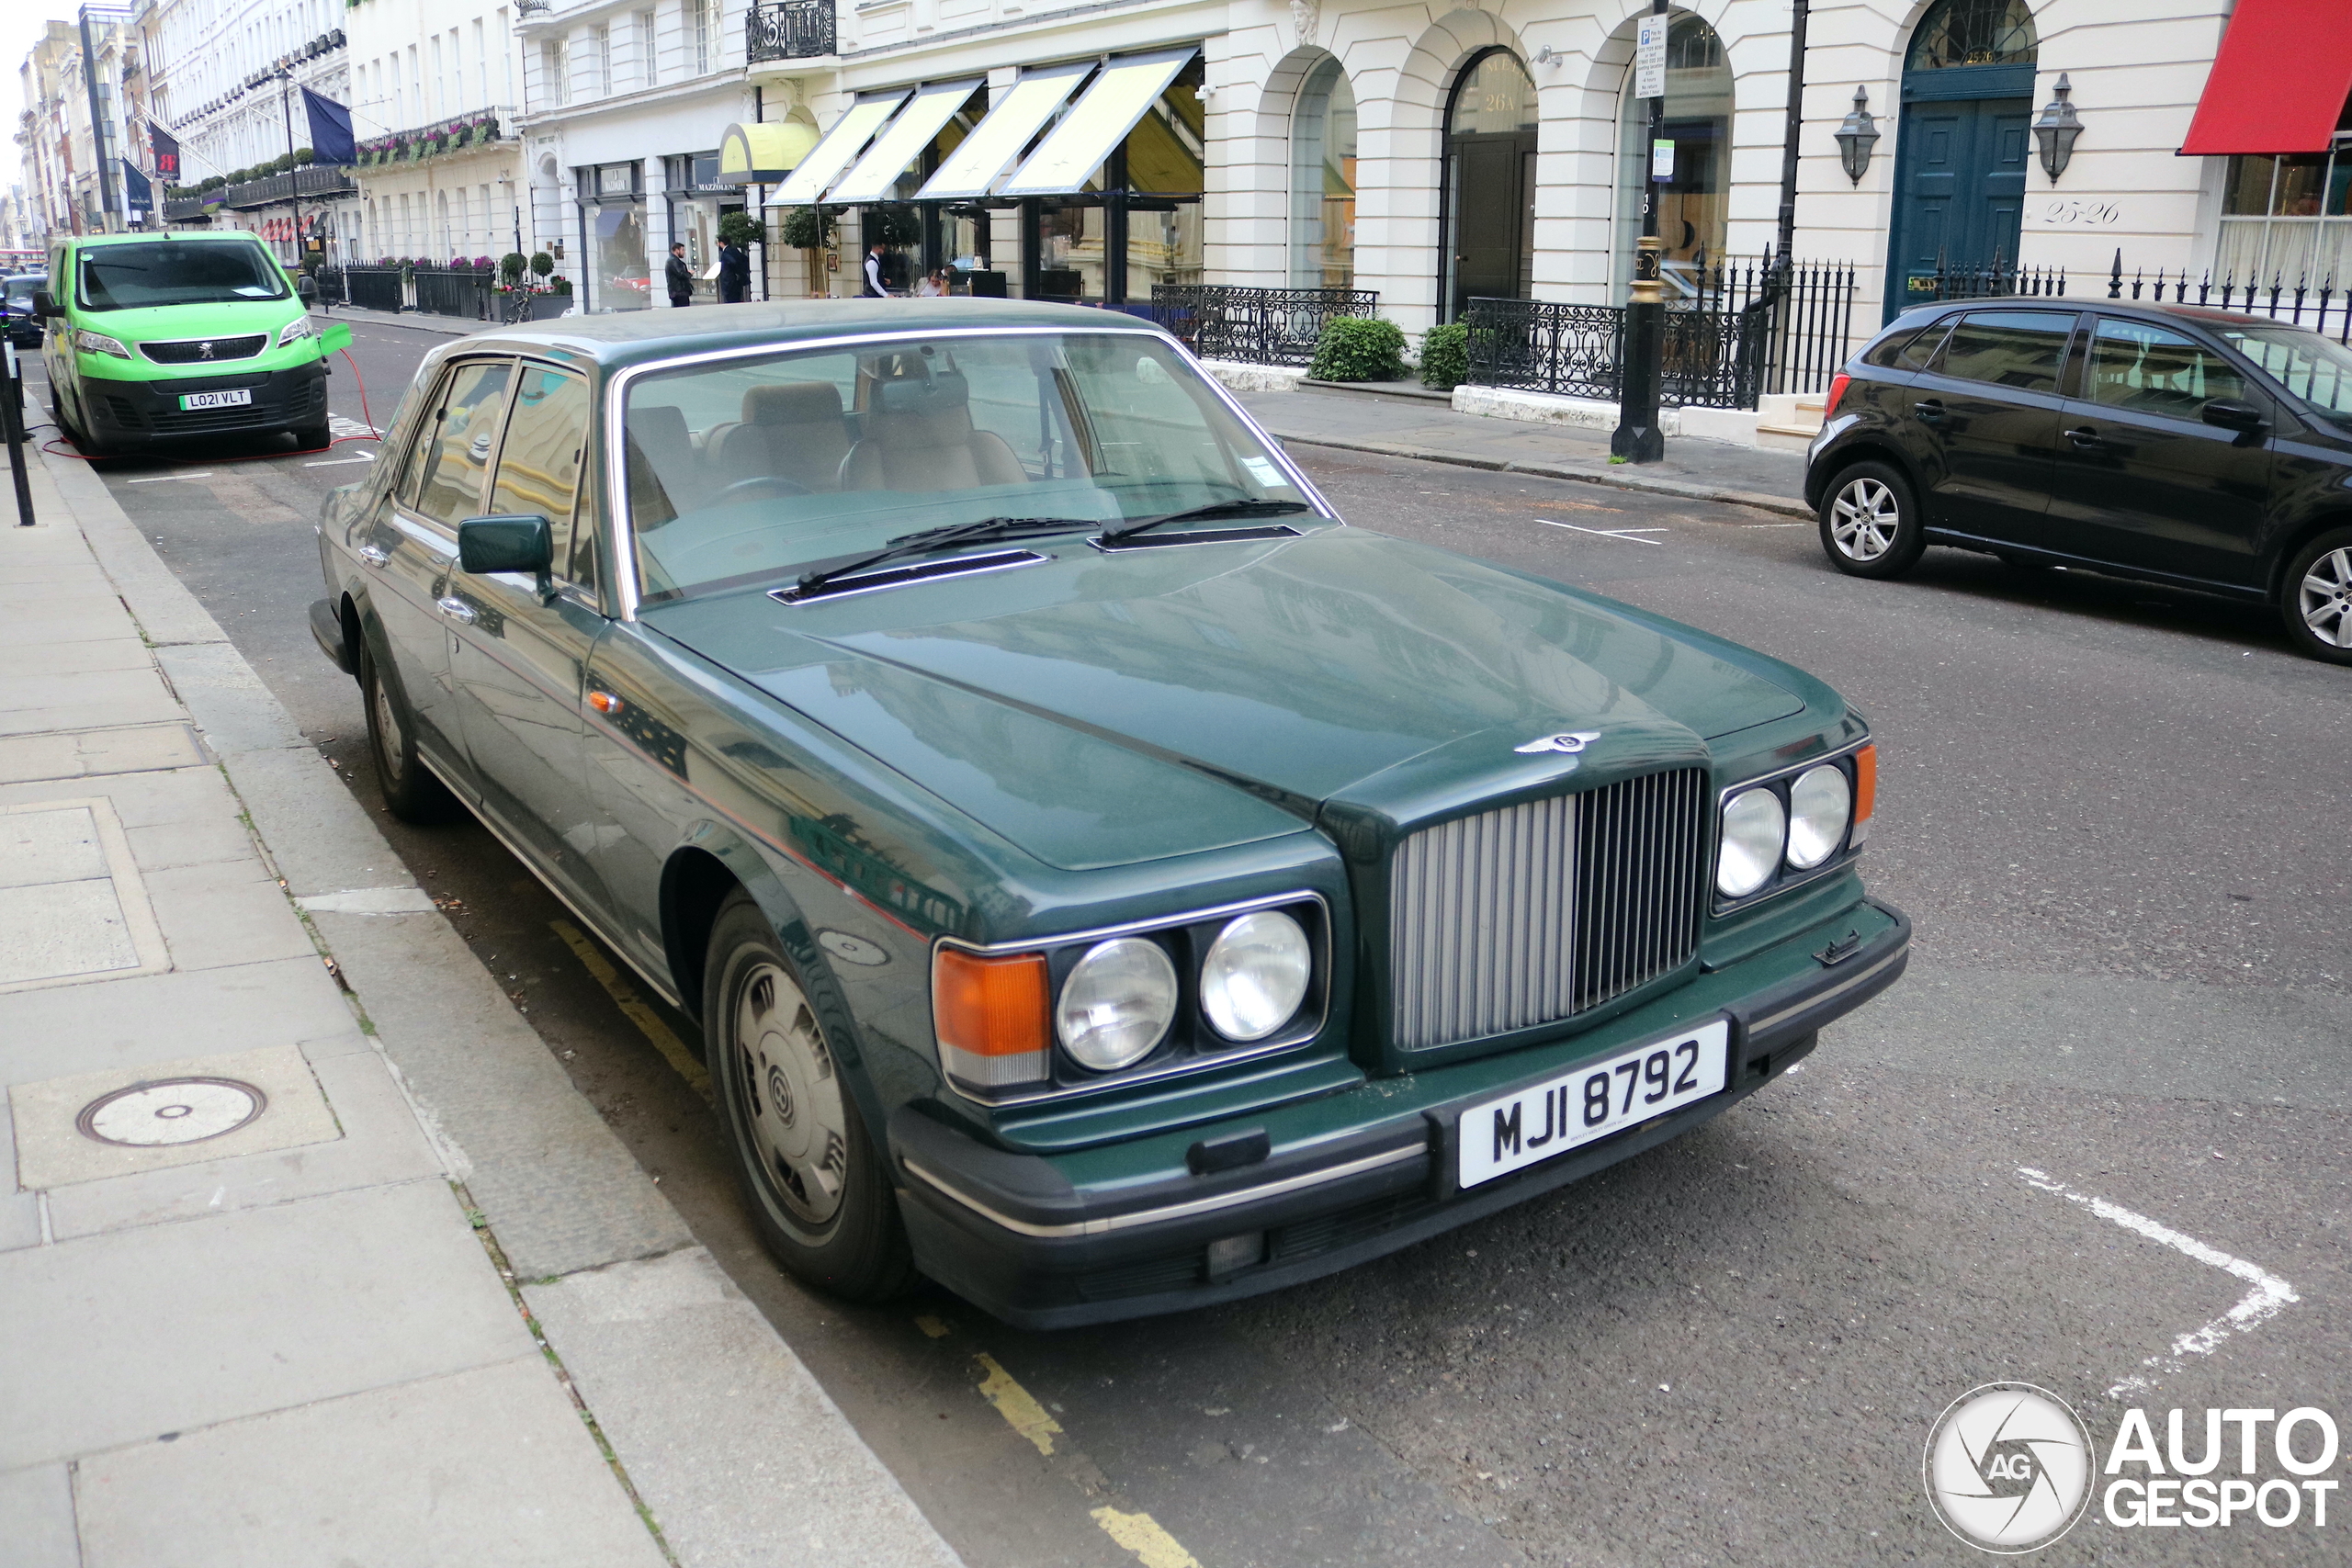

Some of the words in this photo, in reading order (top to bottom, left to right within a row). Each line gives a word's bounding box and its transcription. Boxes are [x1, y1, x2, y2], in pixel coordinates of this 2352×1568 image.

[1486, 93, 1514, 112] 26A
[698, 183, 736, 191] MAZZOLENI
[190, 393, 219, 407] LO21
[221, 390, 244, 403] VLT
[1583, 1039, 1700, 1128] 8792
